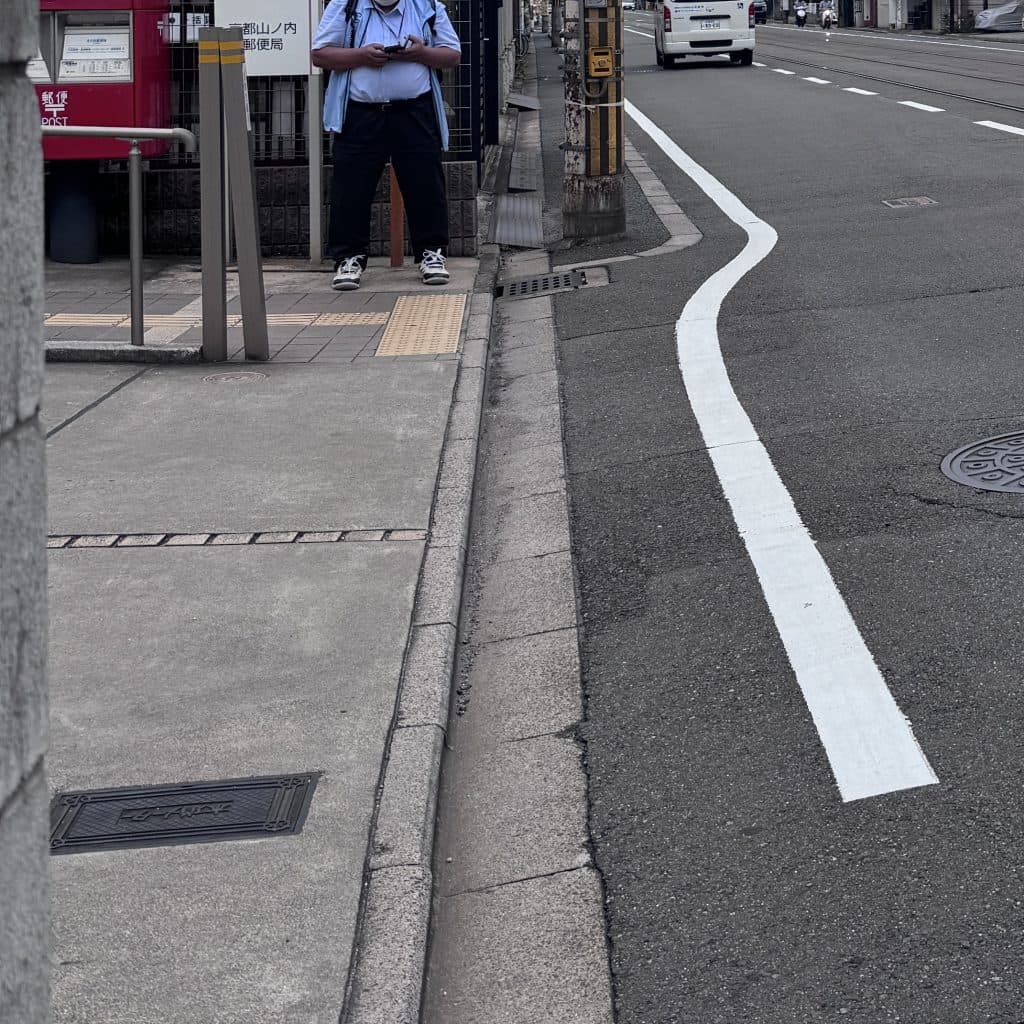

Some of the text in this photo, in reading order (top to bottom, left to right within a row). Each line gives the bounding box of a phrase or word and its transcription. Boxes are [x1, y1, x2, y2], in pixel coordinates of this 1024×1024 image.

[229, 22, 297, 35] 都山ノ内
[243, 38, 284, 51] 郵便局
[41, 91, 68, 105] 郵便
[41, 117, 69, 127] POST
